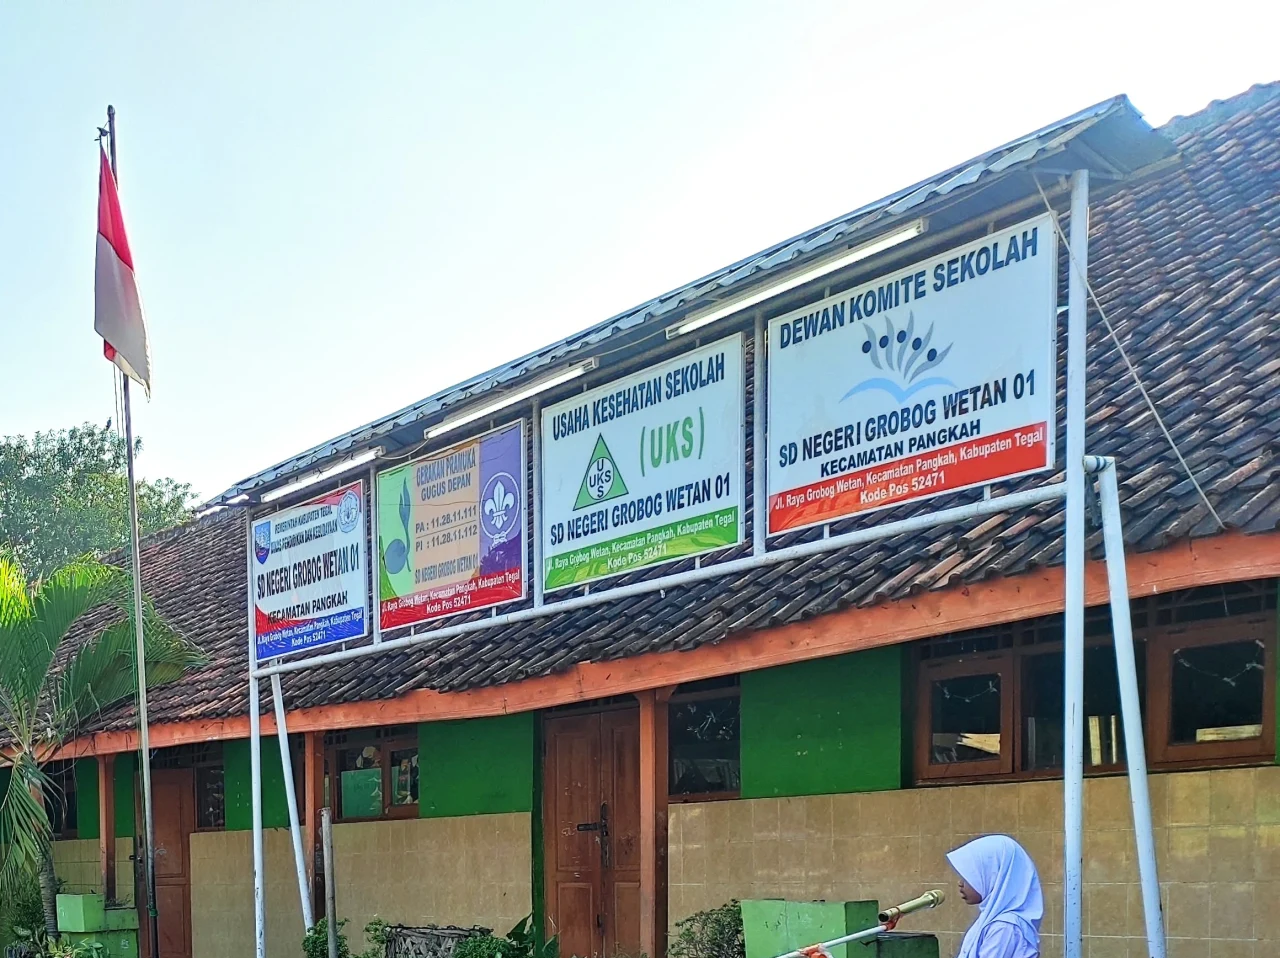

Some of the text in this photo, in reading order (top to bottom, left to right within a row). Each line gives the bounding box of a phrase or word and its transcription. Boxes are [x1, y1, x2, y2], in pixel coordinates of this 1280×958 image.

[780, 226, 1038, 349] DEWAN KOMITE SEKOLAH
[552, 352, 725, 442] USAHA KESEHATAN SEKOLAH
[778, 369, 1036, 468] SD NEGERI GROBOG WETAN 01
[640, 406, 705, 477] (UKS)
[820, 418, 981, 478] KECAMATAN PANGKAH
[417, 447, 476, 487] GERAKAN PRAMUKA
[590, 470, 611, 488] UKS
[786, 493, 805, 509] Raya
[806, 485, 835, 503] Grobog
[836, 476, 865, 494] Wetan,
[866, 464, 914, 486] Kecamatan
[916, 453, 958, 475] Pangkah,
[960, 439, 1012, 462] Kabupaten
[1014, 428, 1043, 449] Tegal
[421, 472, 471, 501] GUGUS DEPAN
[860, 471, 946, 505] Kode Pos 52471
[416, 521, 425, 534] PA
[431, 505, 477, 528] 11.28.11.111
[551, 472, 731, 546] SD NEGERI GROBOG WETAN 01
[416, 540, 423, 552] PI
[432, 525, 477, 547] 11.28.11.112
[555, 558, 569, 571] Raya
[570, 552, 590, 566] Grobog
[590, 547, 610, 561] Wetan,
[612, 537, 645, 554] Kecamatan
[647, 529, 676, 546] Pangkah,
[677, 520, 713, 536] Kabupaten
[715, 510, 735, 527] Tegal
[607, 543, 667, 570] Kode Pos 52471
[257, 542, 359, 600] SD NEGERI GROBOG WETAN 01
[415, 568, 421, 584] SD
[422, 564, 437, 582] NEGERI
[438, 559, 456, 578] GROBOG
[457, 554, 472, 573] WETAN
[478, 575, 504, 589] Kabupaten
[506, 569, 520, 584] Tegal
[267, 590, 348, 624] KECAMATAN PANGKAH
[426, 594, 471, 614] Kode Pos 52471
